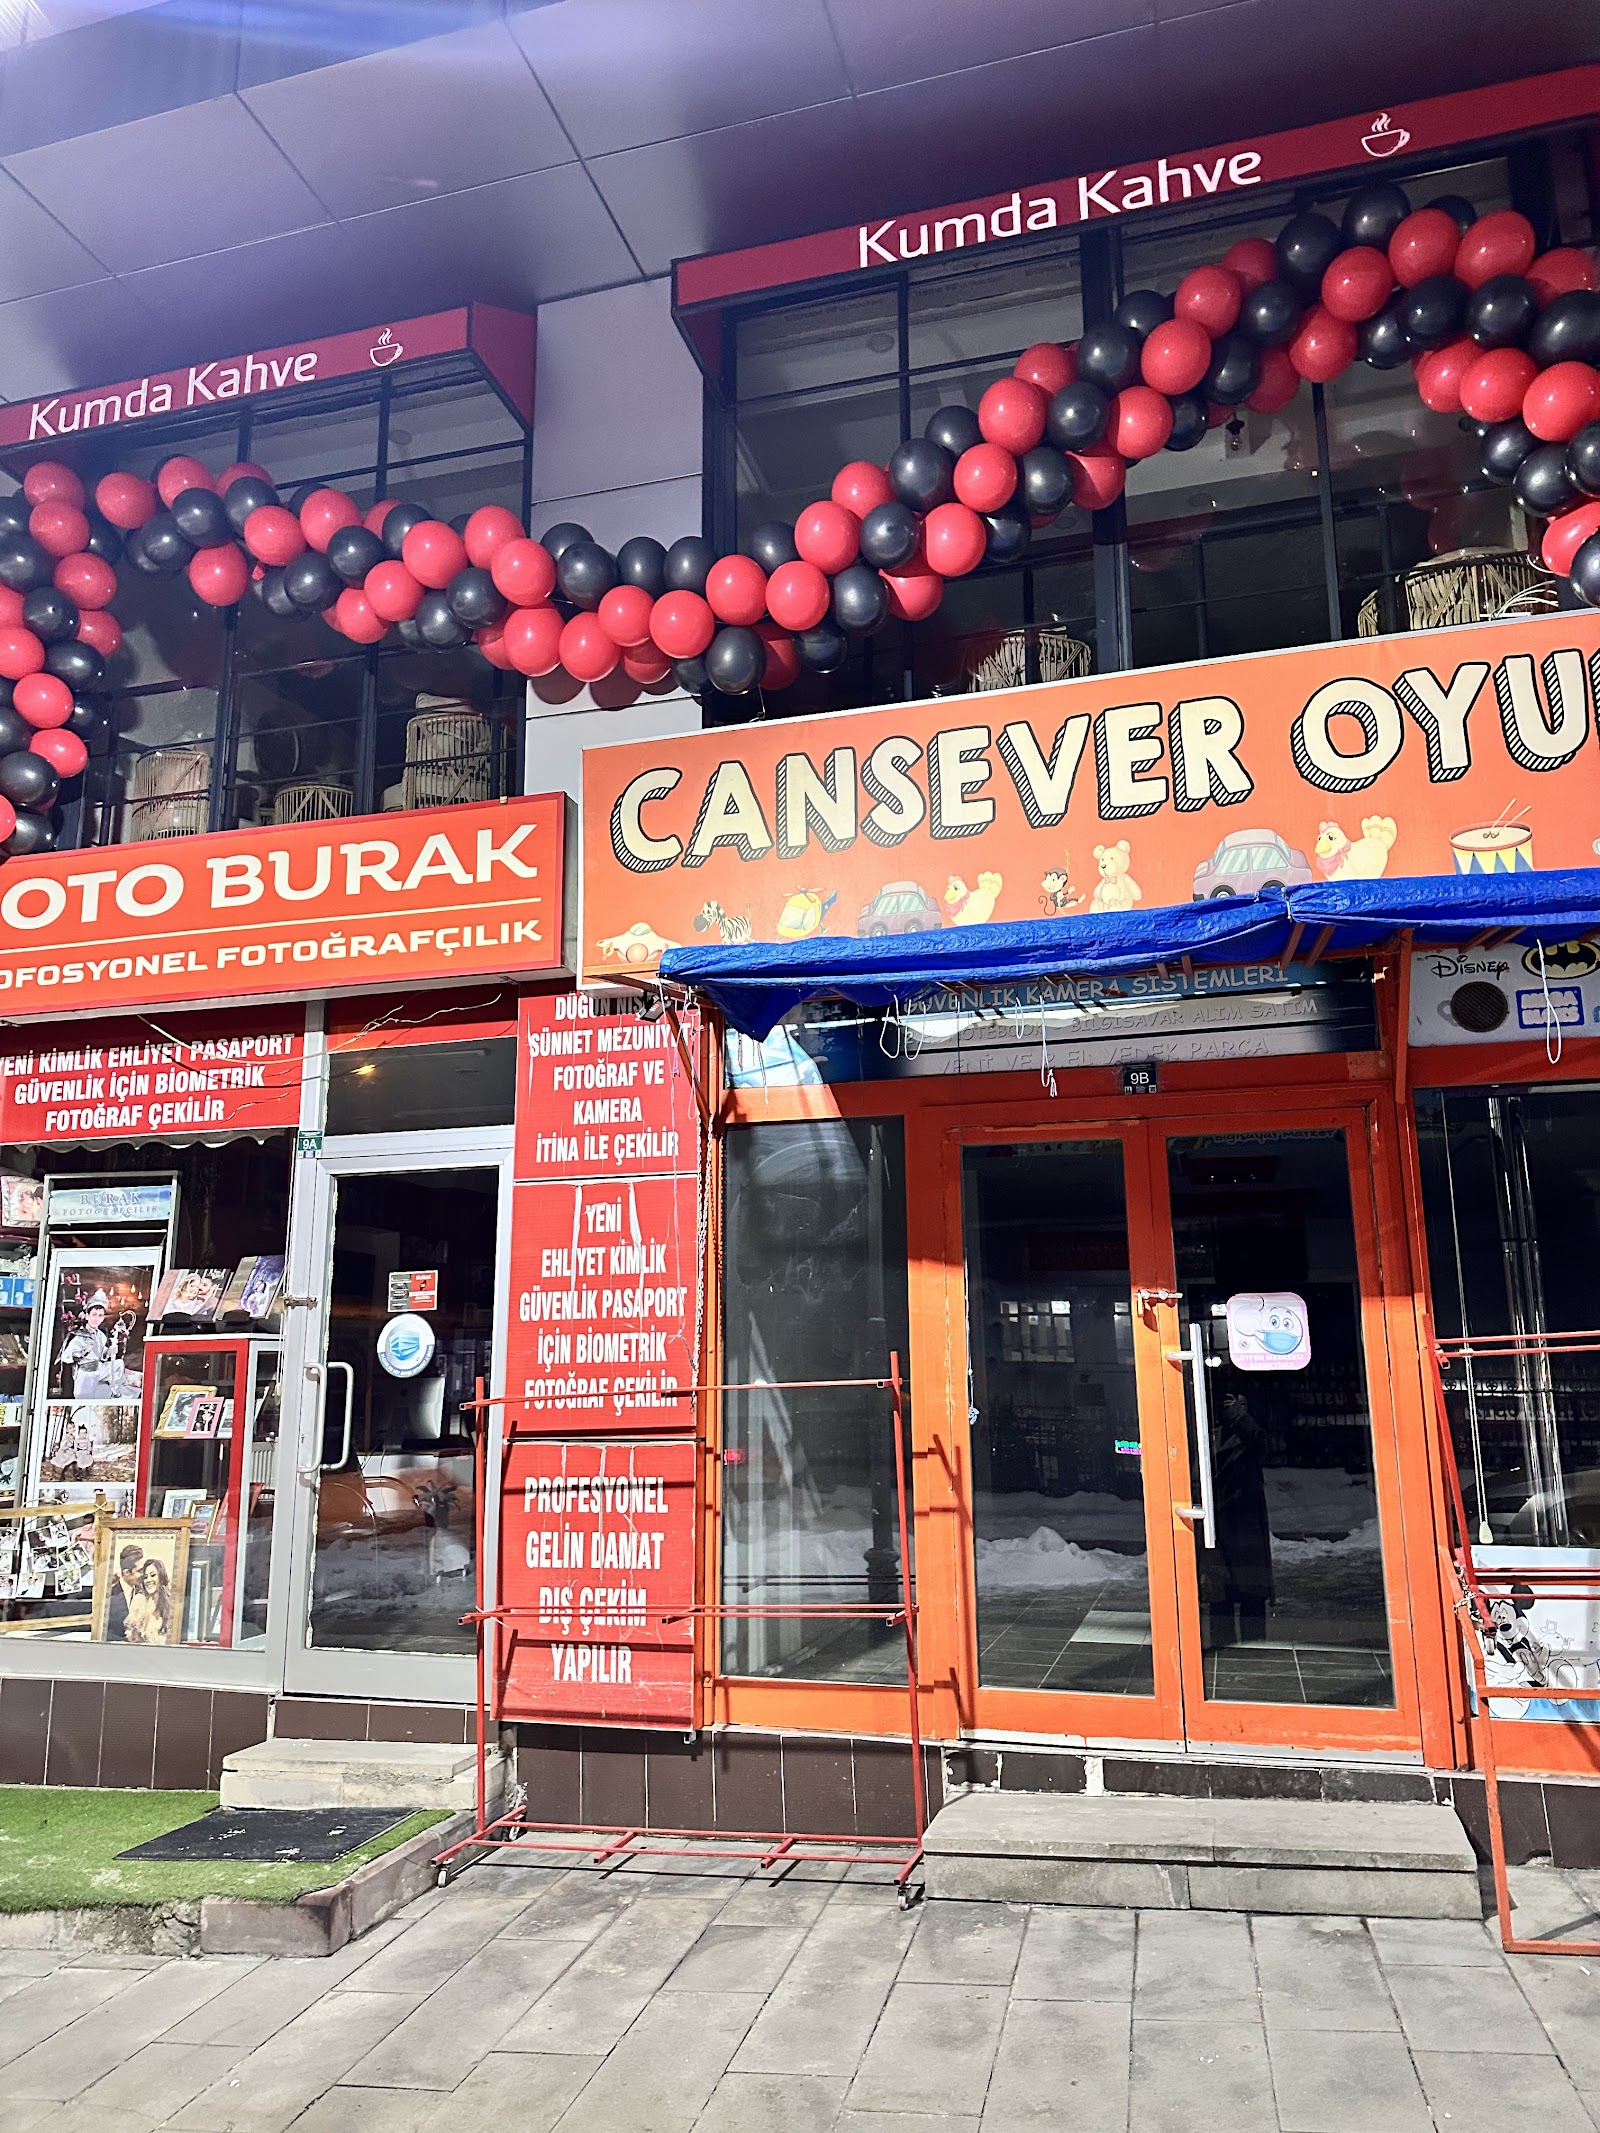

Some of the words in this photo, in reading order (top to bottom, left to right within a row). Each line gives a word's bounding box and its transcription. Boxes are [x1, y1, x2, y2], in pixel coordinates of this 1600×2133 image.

[859, 192, 1057, 267] Kumda
[1079, 150, 1262, 220] Kahve
[28, 379, 172, 440] Kumda
[187, 350, 317, 406] Kahve
[610, 695, 1253, 873] CANSEVER
[1291, 648, 1600, 794] OYU
[1, 863, 184, 930] OTO
[206, 824, 538, 909] BURAK
[217, 919, 542, 969] FOTOĞRAFÇILIK
[1026, 979, 1120, 1004] KAMERA
[39, 1045, 103, 1073] KİMLİK
[108, 1040, 181, 1068] EHLİYET
[190, 1033, 294, 1061] PASAPORT
[530, 1027, 593, 1057] SÜNNET
[15, 1074, 105, 1104] GÜVENLİK
[109, 1070, 149, 1102] İÇİN
[155, 1063, 265, 1094] BİOMETRİK
[553, 1059, 638, 1091] FOTOĞRAF
[643, 1060, 664, 1085] VE
[1130, 1072, 1149, 1084] 9B
[45, 1102, 143, 1132] FOTOĞRAF
[148, 1095, 224, 1130] ÇEKİLİR
[574, 1097, 642, 1125] KAMERA
[303, 1139, 317, 1150] 9A
[536, 1132, 579, 1163] İTİNA
[584, 1130, 608, 1161] İLE
[614, 1126, 679, 1166] ÇEKİLİR
[80, 1191, 141, 1205] BURAK
[585, 1196, 622, 1233] YENİ
[610, 1237, 667, 1275] KİMLİK
[519, 1283, 598, 1321] GÜVENLİK
[602, 1286, 688, 1319] PASAPORT
[537, 1327, 571, 1373] İÇİN
[576, 1325, 667, 1364] BİOMETRİK
[524, 1370, 609, 1410] FOTOĞRAF
[613, 1369, 678, 1416] ÇEKİLİR
[524, 1476, 668, 1514] PROFESYONEL
[526, 1522, 584, 1569] GELİN
[591, 1531, 664, 1570] DAMAT
[538, 1586, 573, 1636] DIŞ
[579, 1579, 647, 1636] ÇEKİM
[551, 1643, 632, 1684] YAPILIR
